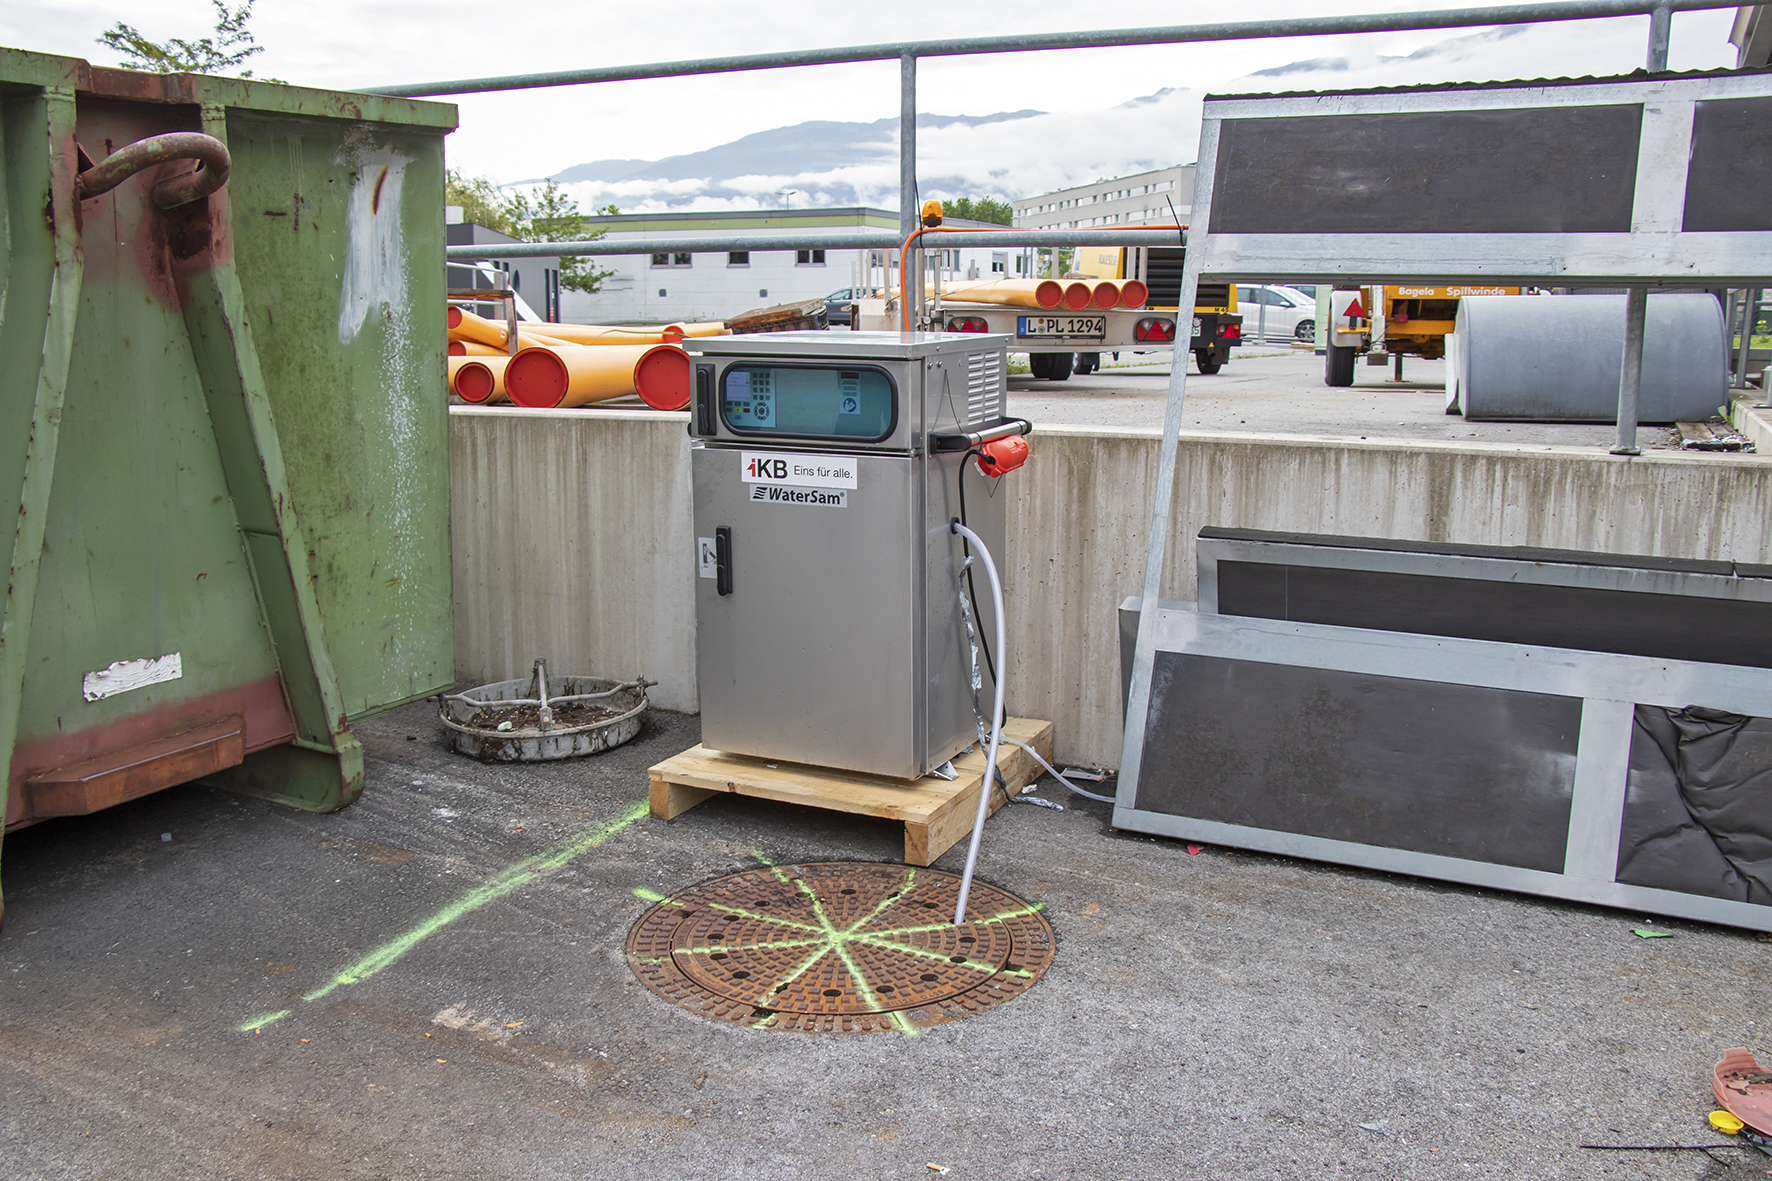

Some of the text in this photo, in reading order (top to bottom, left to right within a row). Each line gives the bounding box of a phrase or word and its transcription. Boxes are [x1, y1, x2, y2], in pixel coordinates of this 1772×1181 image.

[1098, 254, 1118, 266] KAESER
[1398, 287, 1506, 298] Bagela Spillwinde
[1027, 319, 1102, 333] L PL 1294
[793, 465, 815, 476] Eins
[817, 467, 830, 477] für
[833, 468, 853, 479] alle.
